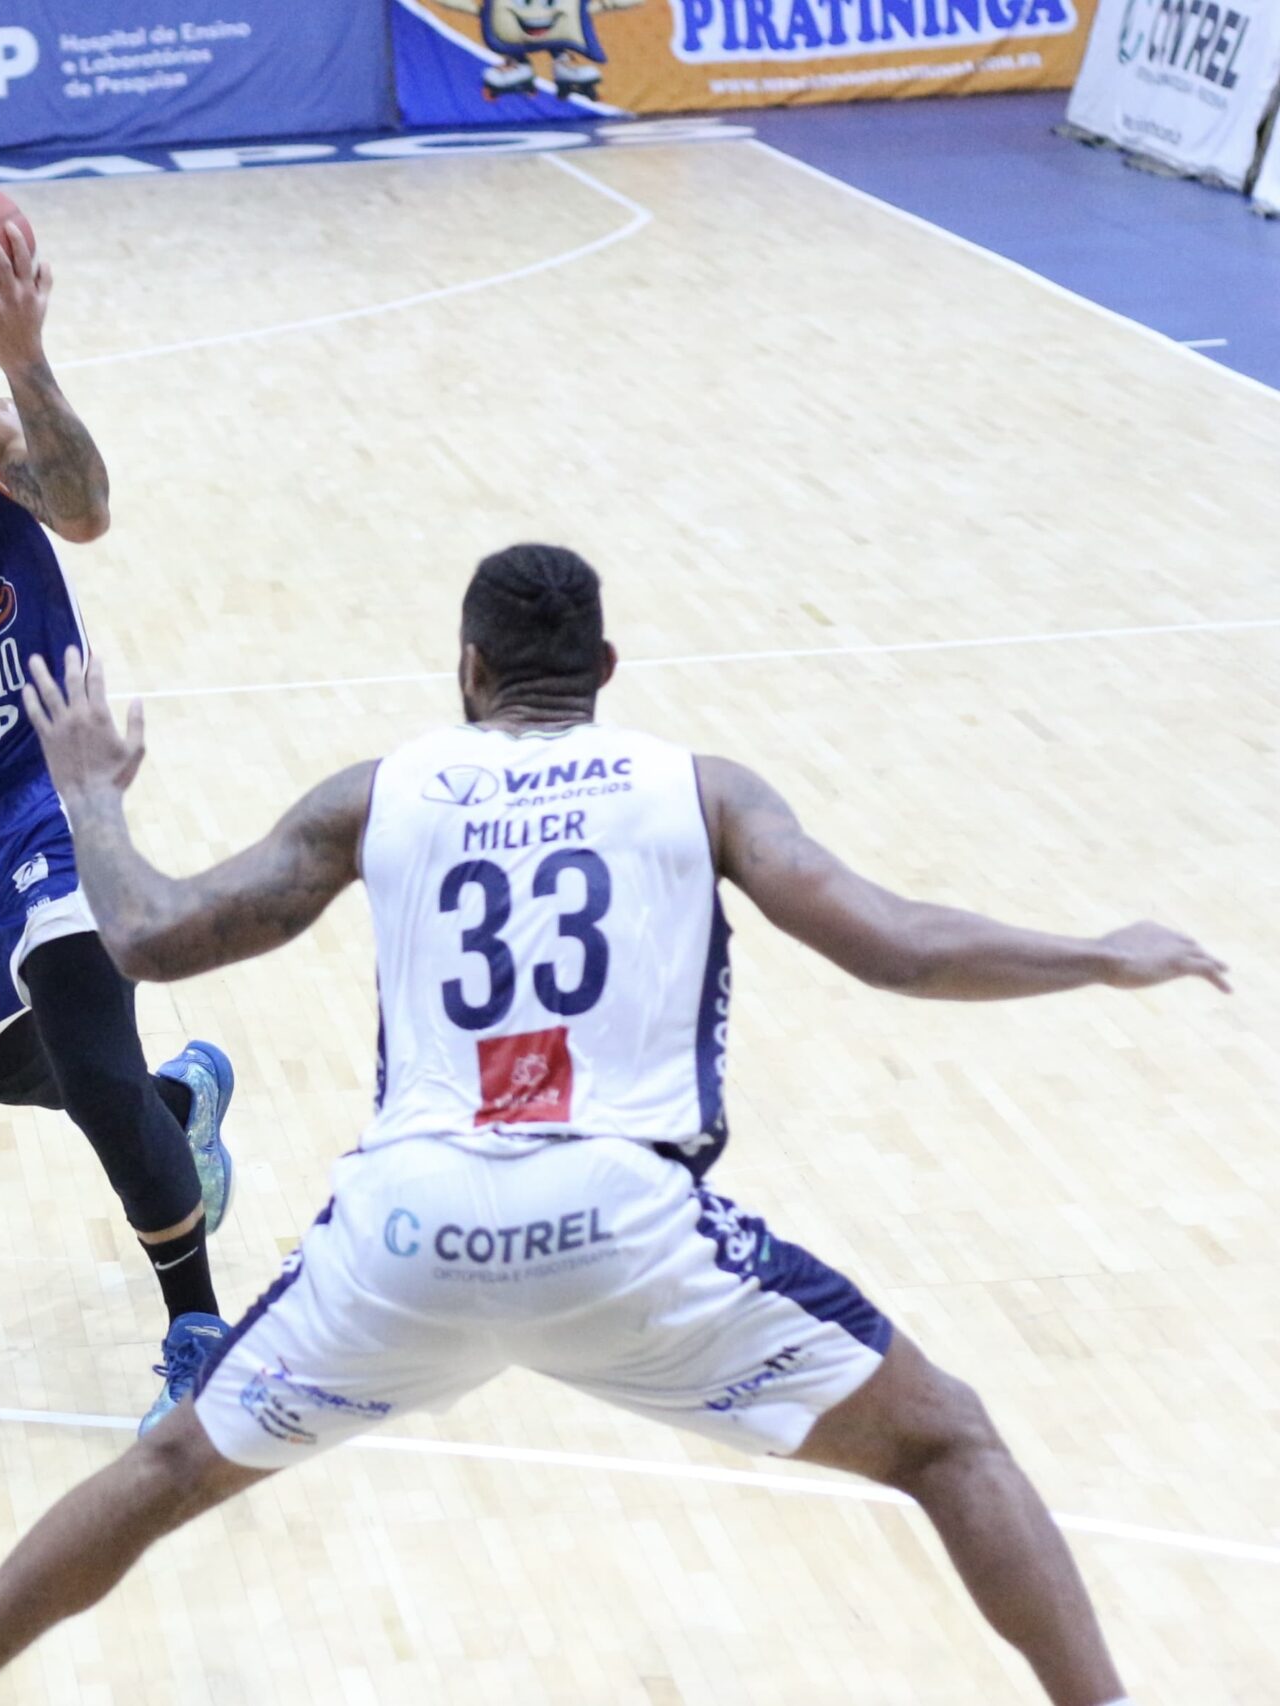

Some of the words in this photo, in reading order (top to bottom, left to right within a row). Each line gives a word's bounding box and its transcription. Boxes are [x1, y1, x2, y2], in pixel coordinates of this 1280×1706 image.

[60, 26, 148, 52] Hospital
[148, 24, 178, 45] de
[180, 19, 252, 42] Ensino
[62, 78, 93, 98] de
[94, 69, 189, 96] Pesquisa
[504, 757, 633, 794] VINAC
[438, 848, 612, 1032] 33
[434, 1208, 614, 1264] COTREL
